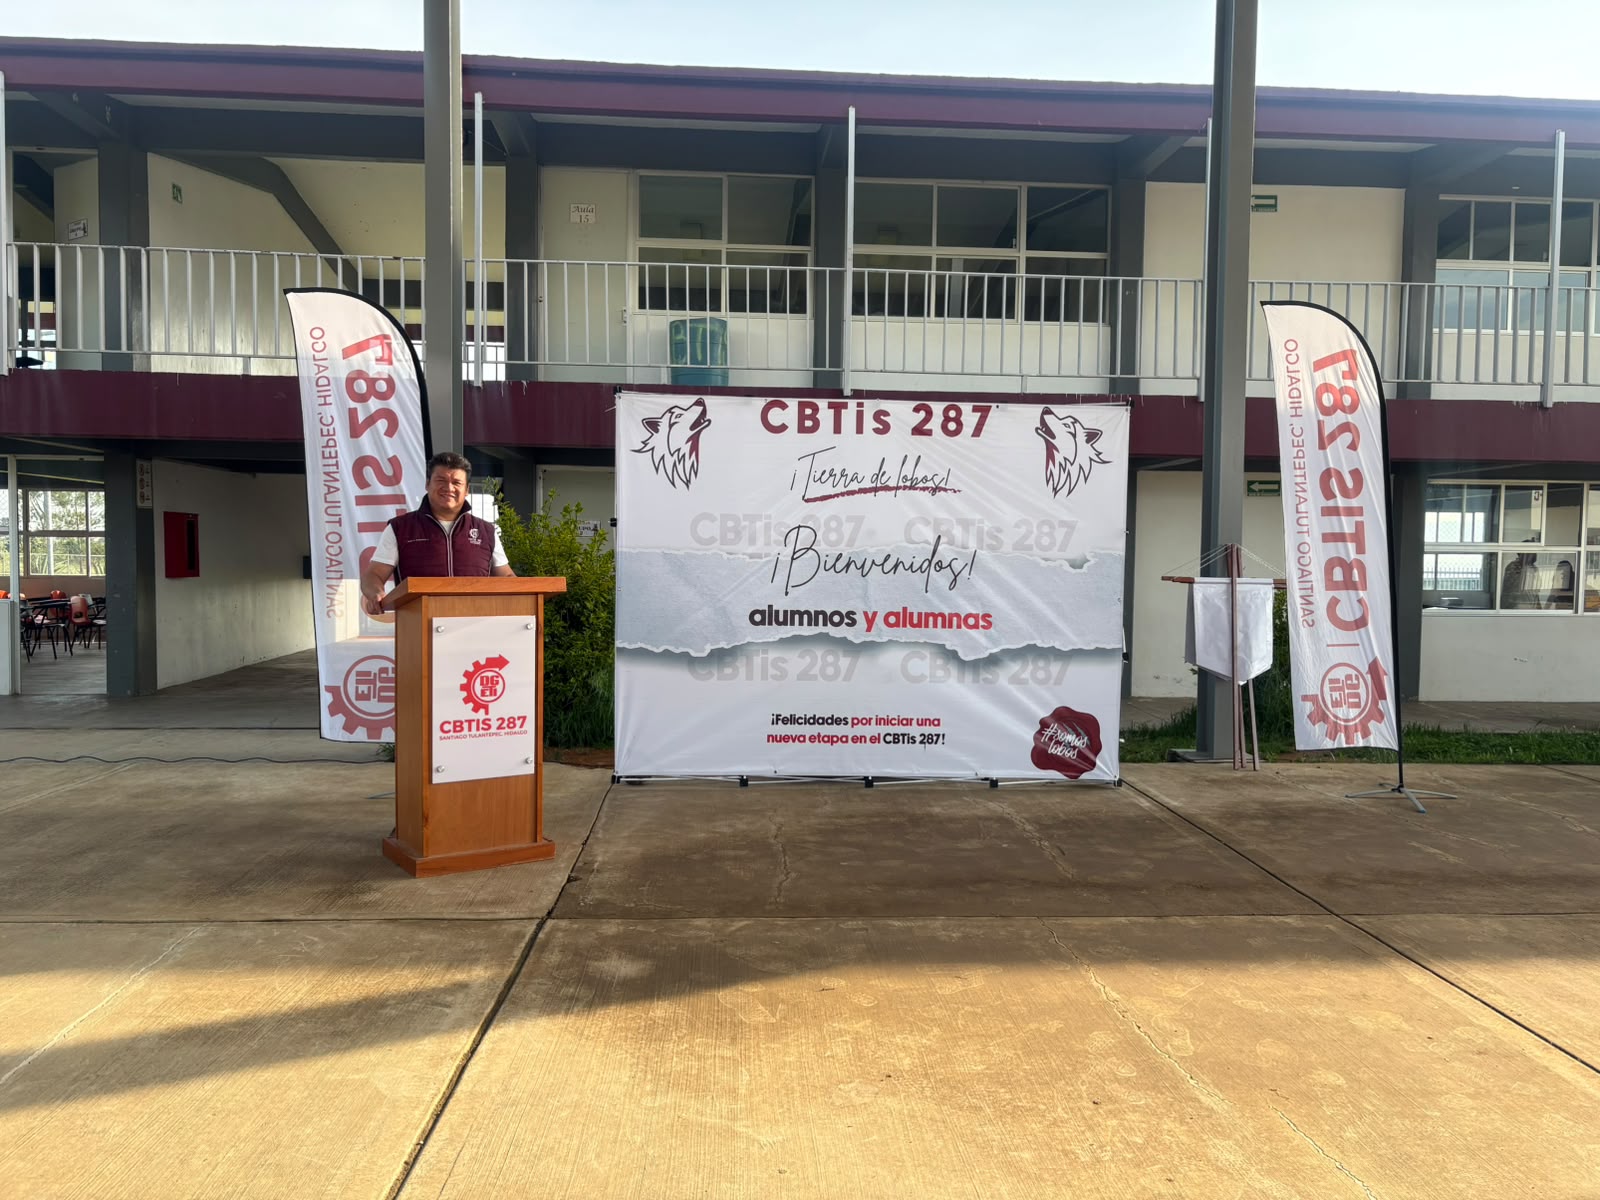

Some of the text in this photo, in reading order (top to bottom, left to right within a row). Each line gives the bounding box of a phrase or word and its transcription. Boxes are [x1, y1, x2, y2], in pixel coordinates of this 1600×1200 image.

[760, 399, 993, 438] CBTis 287
[870, 457, 891, 498] de
[894, 454, 951, 498] lobos!
[690, 511, 866, 548] CBTis 287
[904, 516, 1079, 553] CBTis 287
[770, 524, 977, 597] ¡Bienvenidos!
[748, 604, 993, 632] alumnos y alumnas
[796, 649, 862, 682] 287
[1007, 654, 1073, 686] 287
[439, 715, 527, 734] CBTIS 287
[771, 713, 941, 728] ¡Felicidades por iniciar una
[1041, 723, 1088, 748] #somos
[767, 732, 946, 746] nueva etapa en el CBTis 287!
[1048, 740, 1079, 759] lobos
